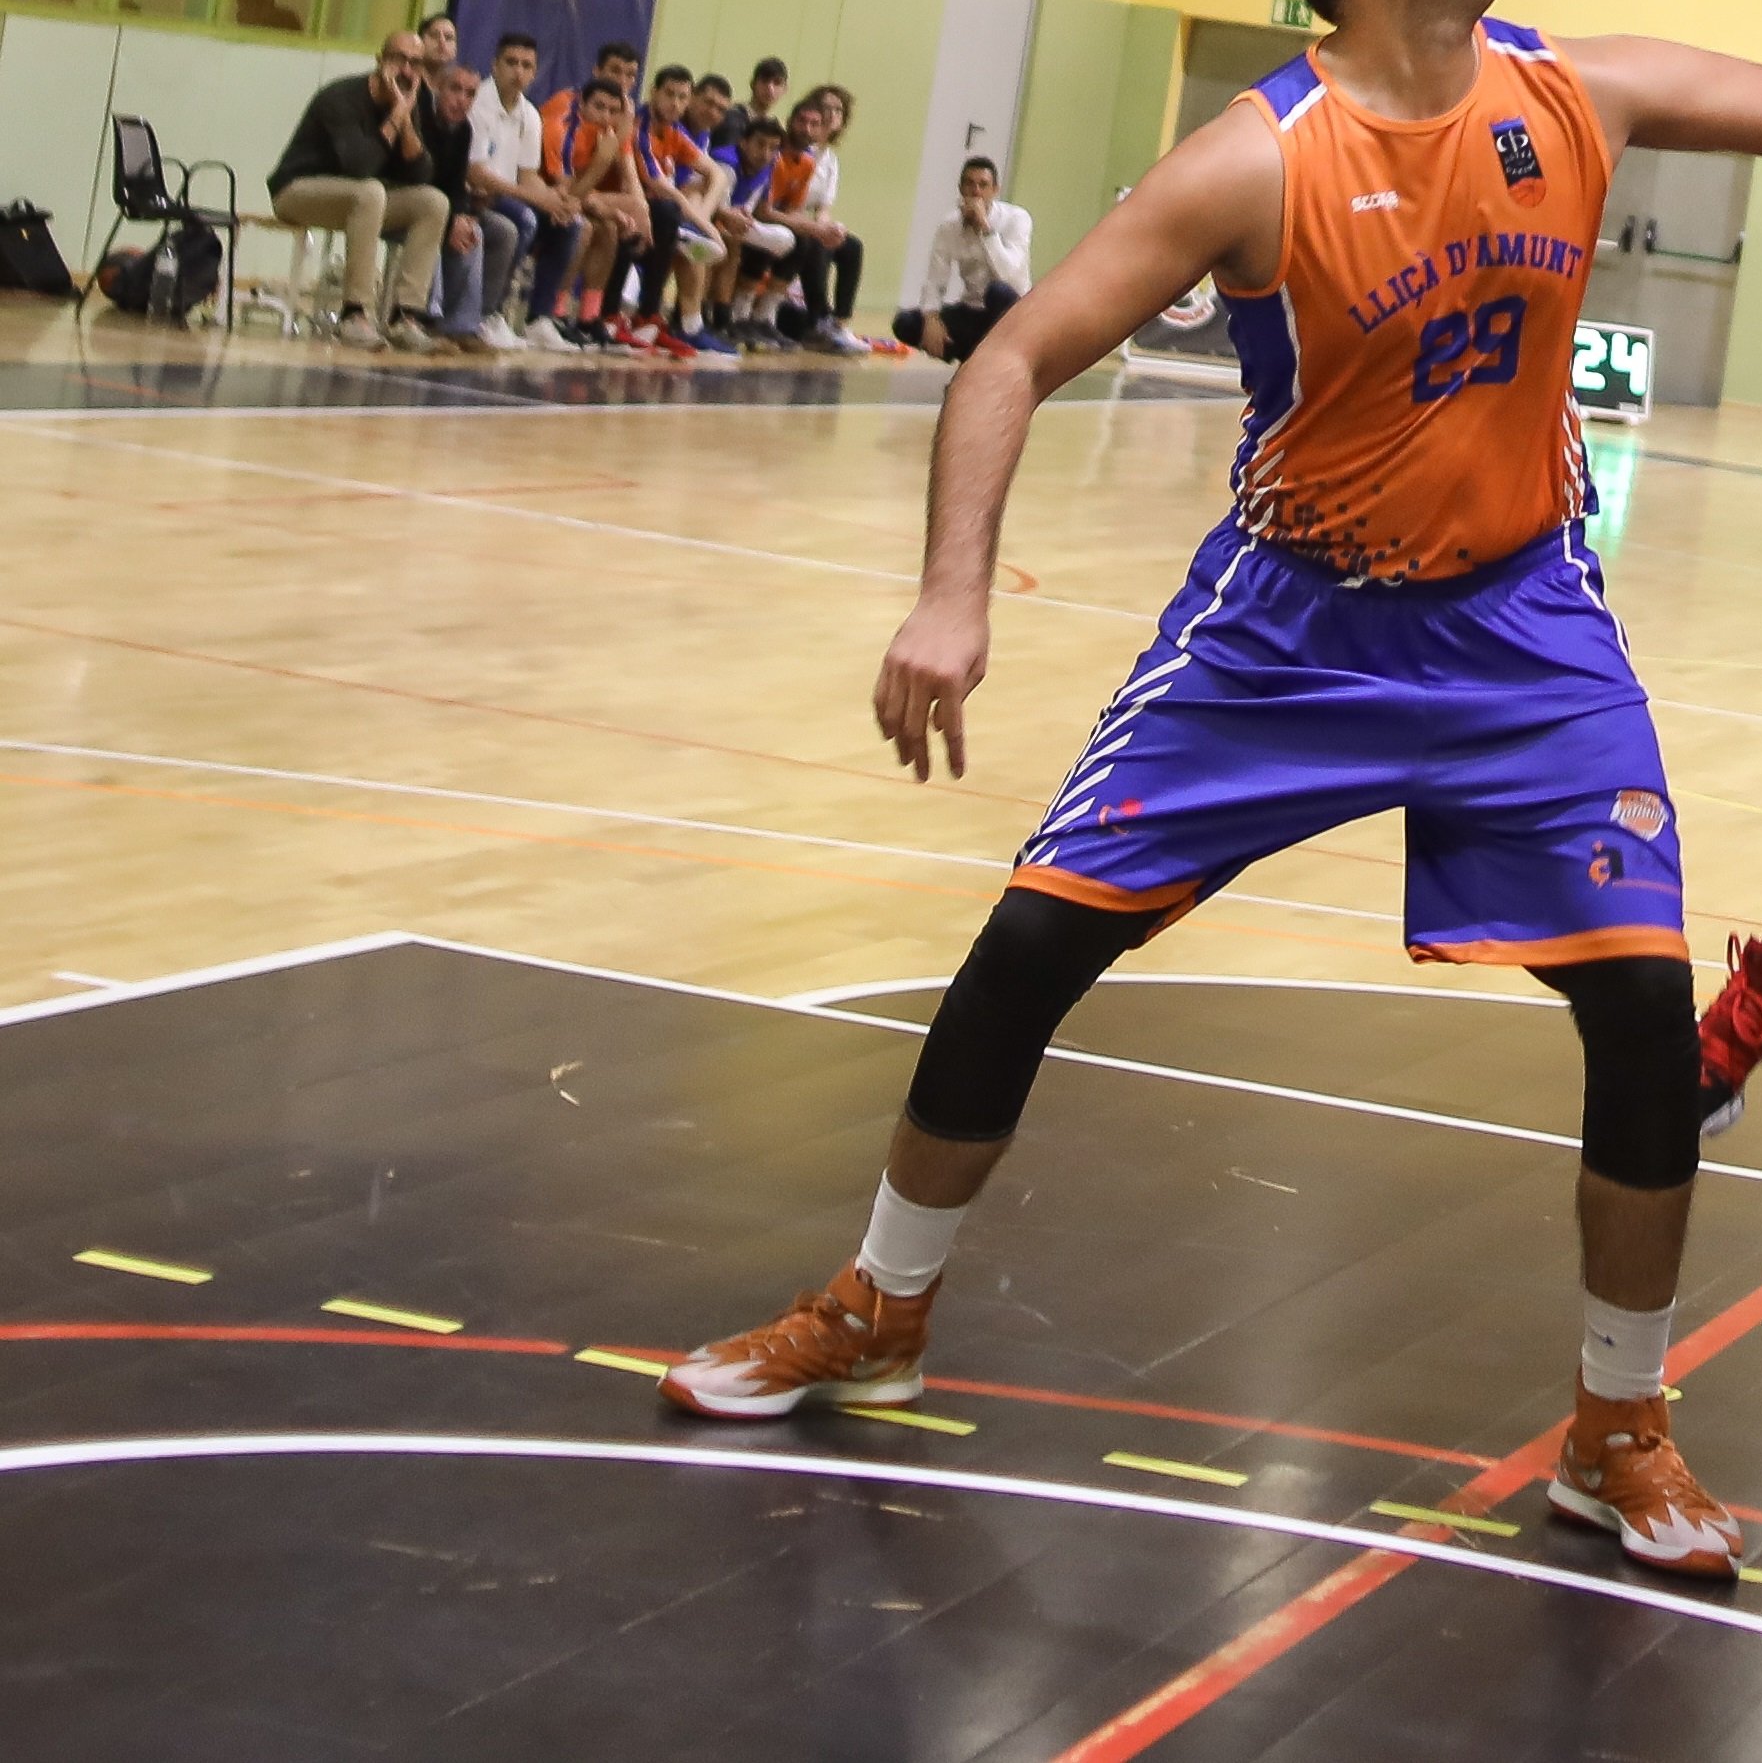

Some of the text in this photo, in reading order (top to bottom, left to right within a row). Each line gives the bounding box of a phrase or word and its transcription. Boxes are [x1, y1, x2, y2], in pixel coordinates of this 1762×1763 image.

[1348, 232, 1583, 334] LLIÇÀ D'AMUNT
[1411, 294, 1527, 404] 29
[1571, 326, 1649, 396] 24
